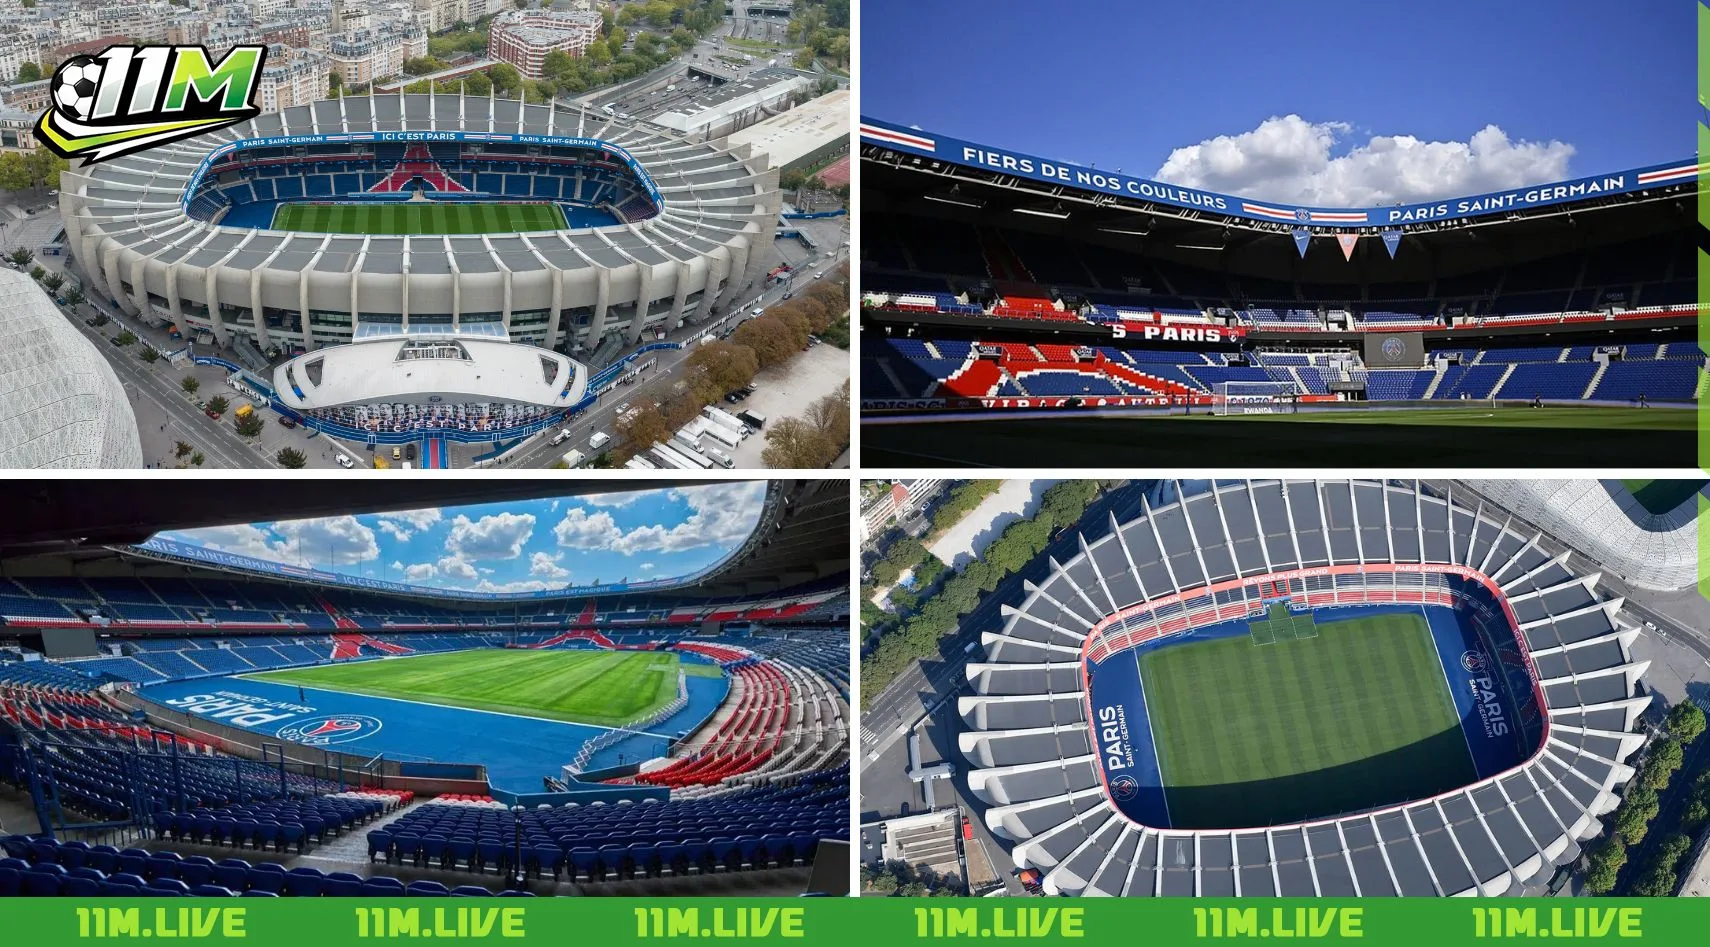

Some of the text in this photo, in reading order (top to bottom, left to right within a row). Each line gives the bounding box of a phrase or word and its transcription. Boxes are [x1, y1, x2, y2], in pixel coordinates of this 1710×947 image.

[242, 136, 323, 147] PARIS SAINT-GERMAIN
[542, 138, 597, 146] SAINT-GERMAIN
[963, 146, 1227, 210] FIERS DE NOS COULEURS
[1389, 176, 1624, 222] PARIS SAINT-GERMAIN
[1144, 326, 1221, 342] PARIS
[459, 421, 513, 432] PARIS
[184, 547, 276, 571] SAINT-GERMAIN
[343, 576, 355, 585] ICI
[383, 582, 406, 591] PARIS
[1277, 572, 1298, 580] PLUS
[1299, 568, 1328, 578] GRAND
[1421, 565, 1485, 583] SAINT-GERMAIN
[1115, 595, 1180, 620] SAINT-GERMAIN
[165, 694, 297, 728] PARIS
[1476, 677, 1508, 737] PARIS
[1099, 705, 1126, 771] PARIS
